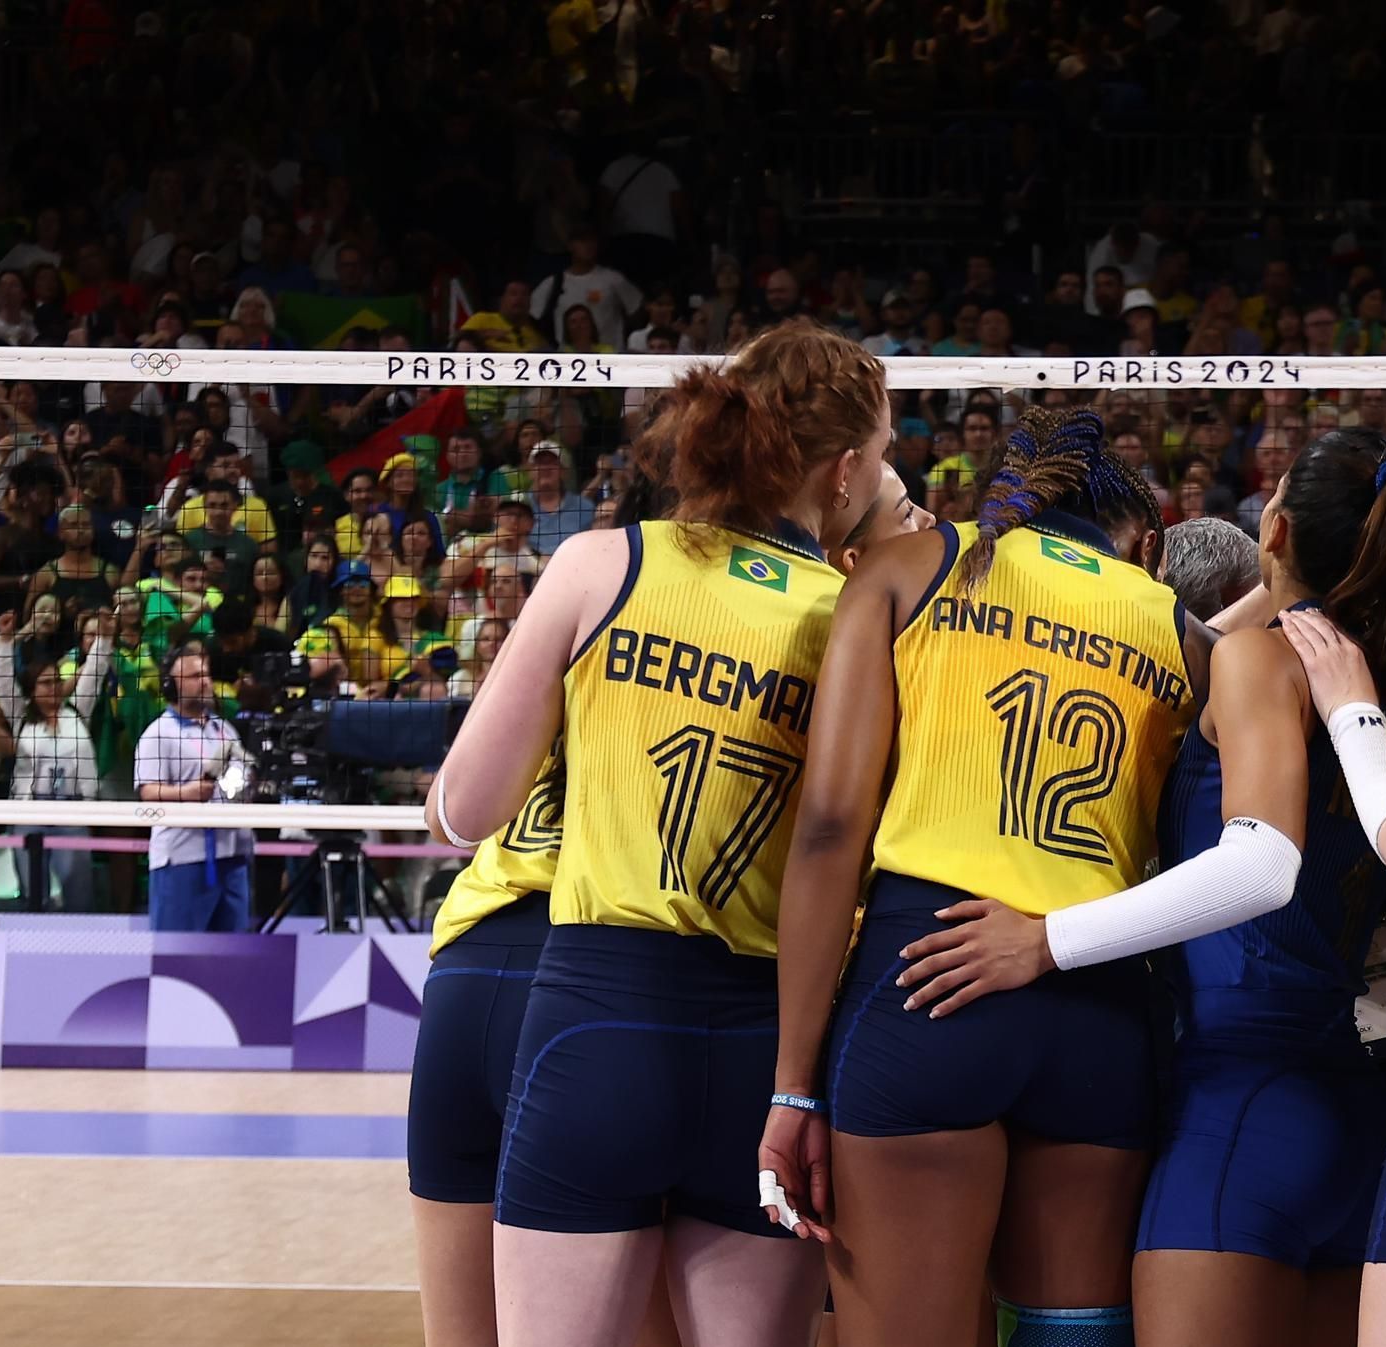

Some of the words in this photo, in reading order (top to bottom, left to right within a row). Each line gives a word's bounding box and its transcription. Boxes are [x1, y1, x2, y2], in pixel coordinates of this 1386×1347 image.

[514, 358, 611, 382] 2024
[1201, 360, 1300, 383] 2024
[605, 627, 817, 736] BERGMA
[932, 596, 1013, 640] ANA
[1024, 614, 1187, 712] CRISTINA
[646, 723, 804, 911] 17
[984, 667, 1126, 866] 12
